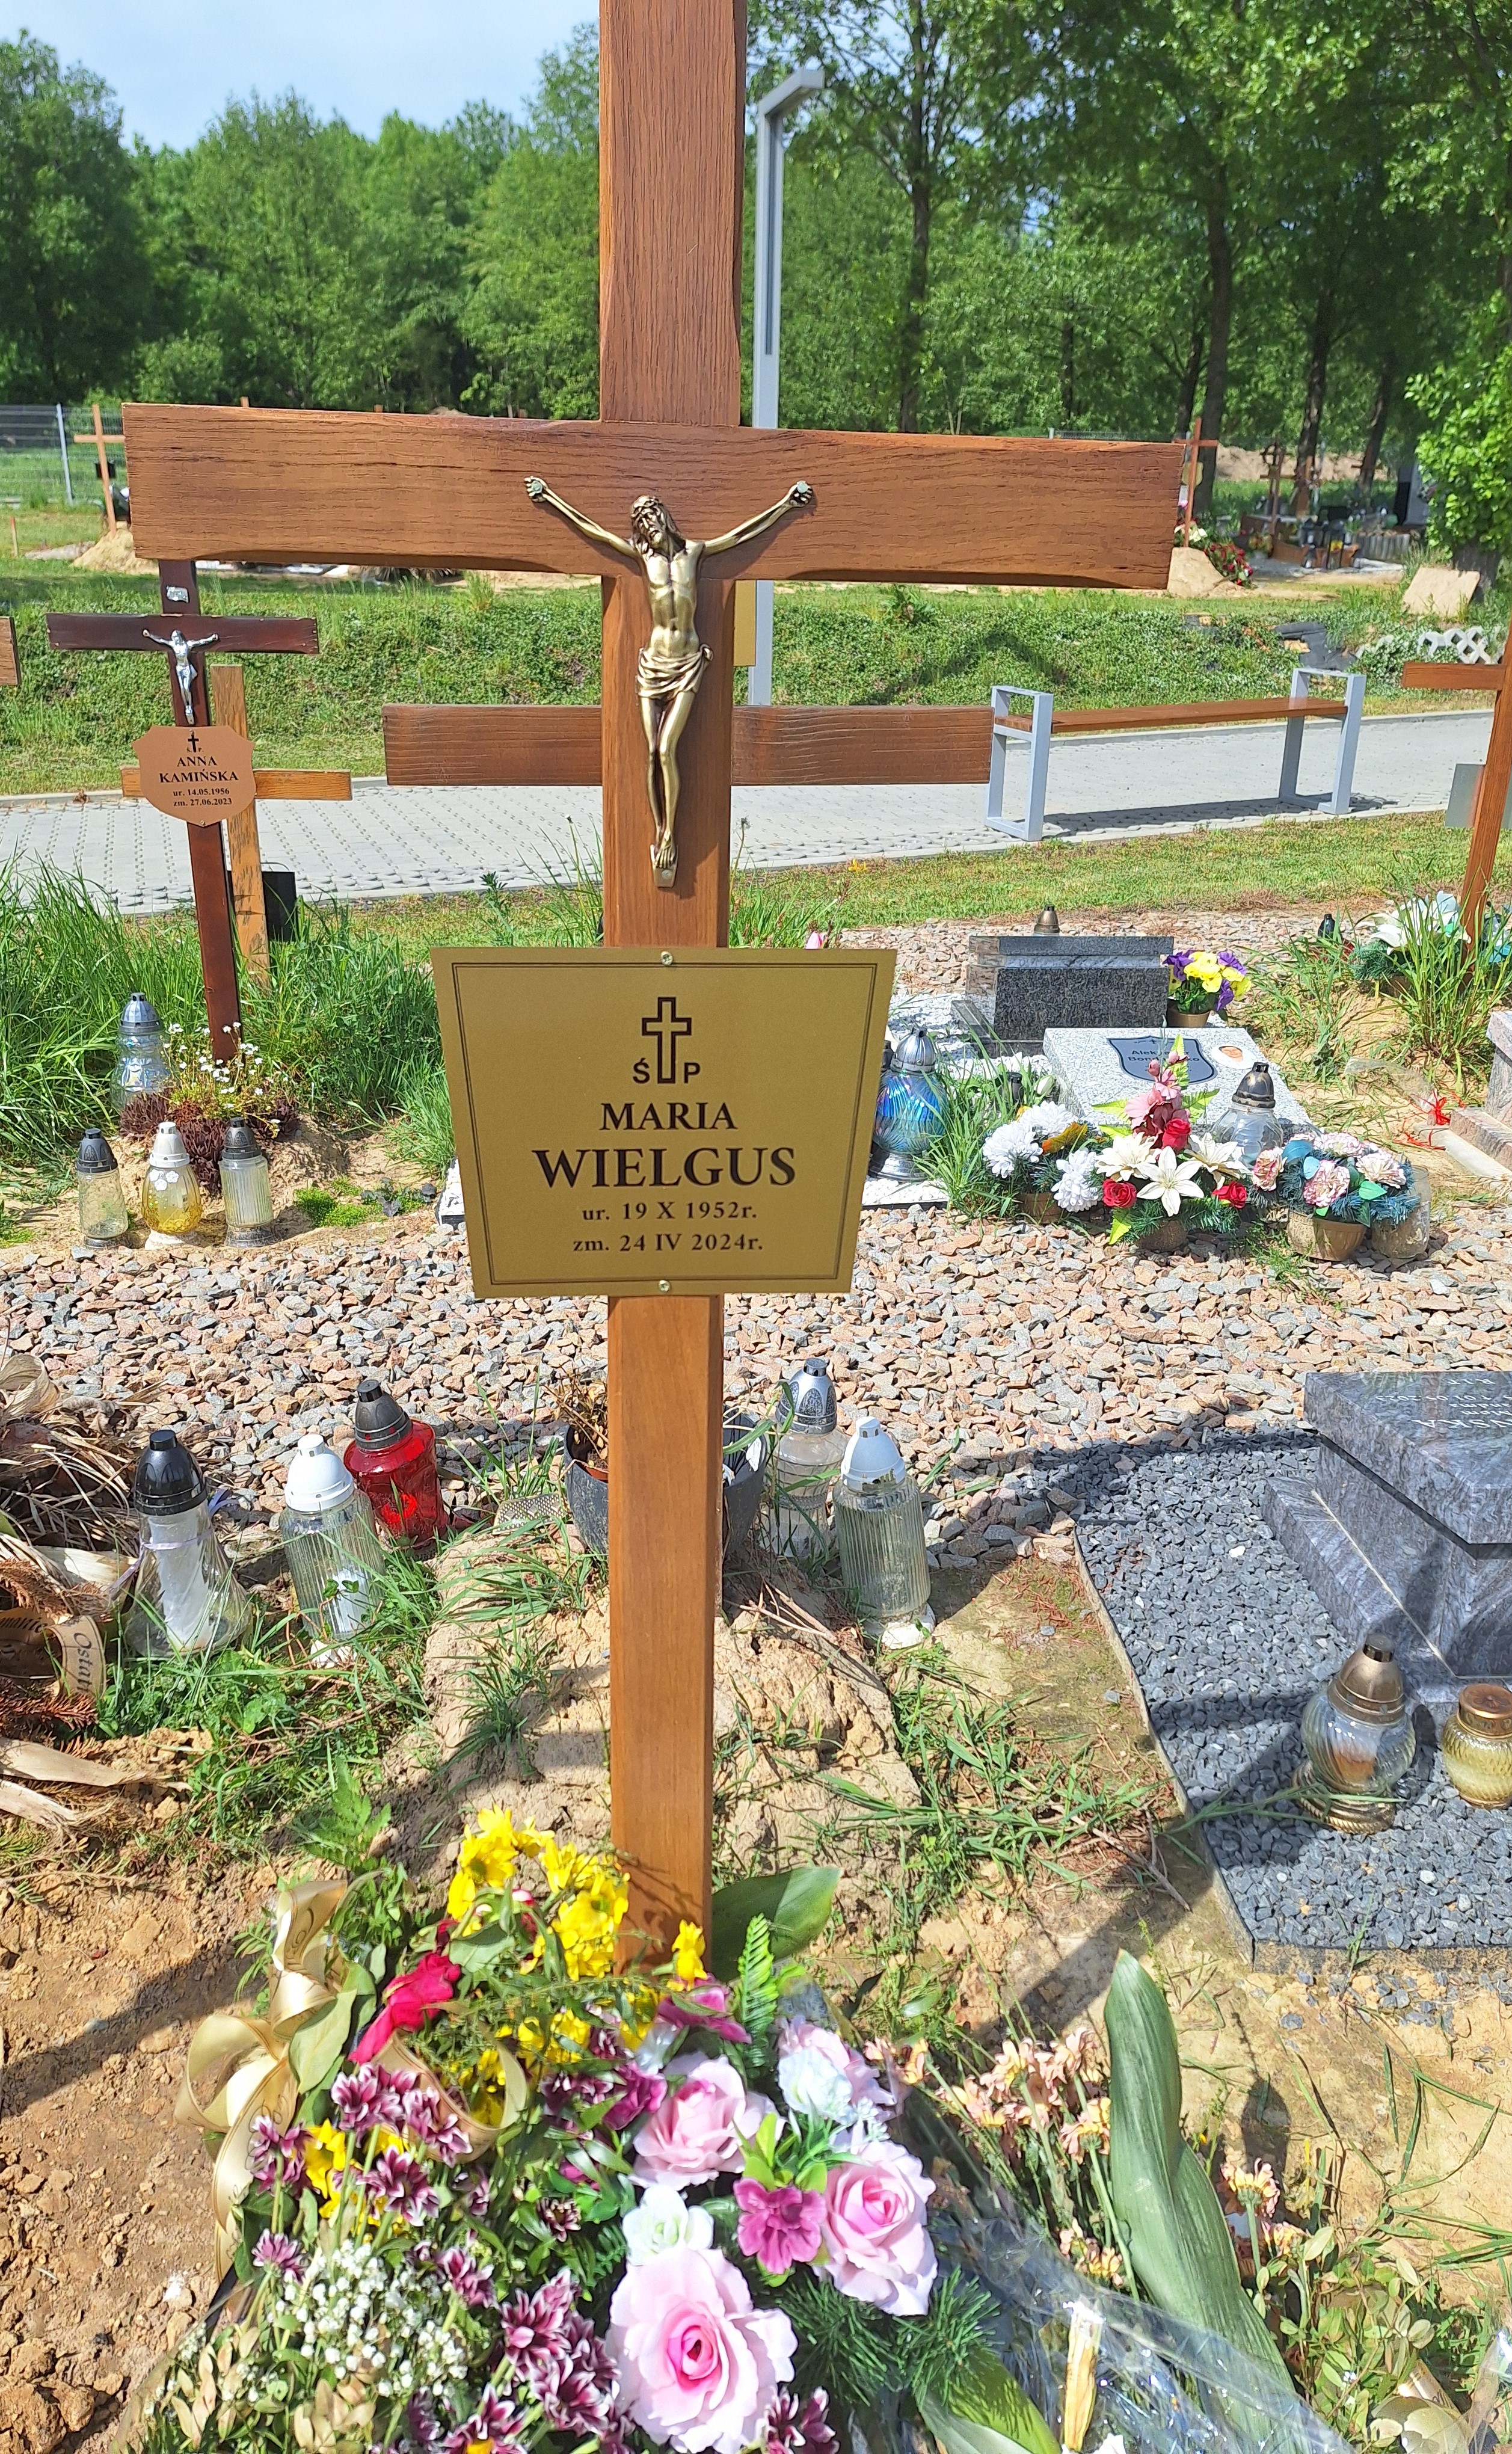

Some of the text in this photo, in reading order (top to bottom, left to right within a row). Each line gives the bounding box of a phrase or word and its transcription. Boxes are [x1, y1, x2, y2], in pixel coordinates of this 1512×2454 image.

[177, 755, 218, 767] ANNA
[159, 768, 239, 783] KAMIŃSKA
[188, 787, 230, 796] 14.05.1956
[190, 798, 232, 806] 27.06.2023
[632, 1057, 701, 1084] Ś P
[598, 1102, 739, 1131] MARIA
[531, 1147, 796, 1189] WIELGUS
[582, 1201, 757, 1220] ur. 19 X 1952r.
[573, 1233, 763, 1252] zm. 24 IV 2024r.
